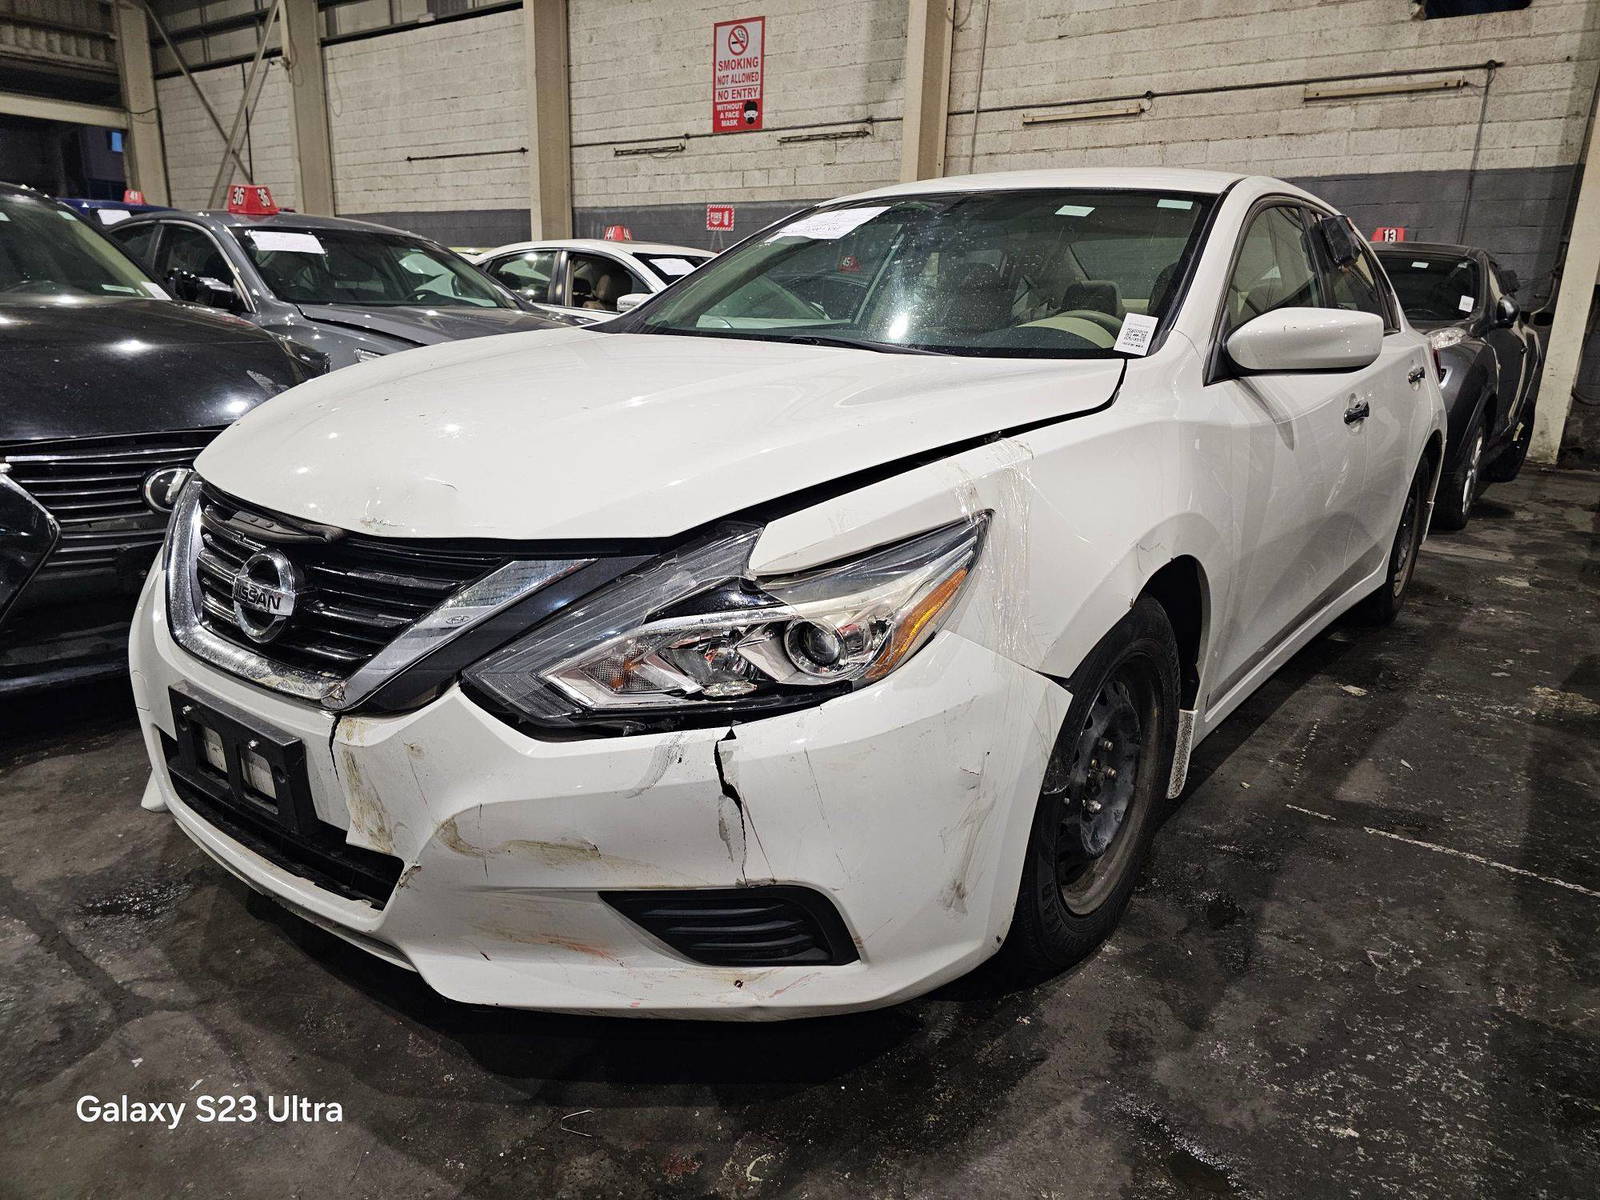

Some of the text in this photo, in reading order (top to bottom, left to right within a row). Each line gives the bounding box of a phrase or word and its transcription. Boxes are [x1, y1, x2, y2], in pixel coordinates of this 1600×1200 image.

[718, 57, 759, 72] SMOKING
[717, 72, 759, 86] NOT ALLOWED
[717, 87, 758, 101] NO ENTRY
[717, 102, 743, 111] WITHOUT
[720, 111, 725, 119] A
[721, 119, 738, 127] MASK
[232, 187, 245, 205] 36
[257, 188, 271, 207] 36
[1383, 228, 1397, 243] 13
